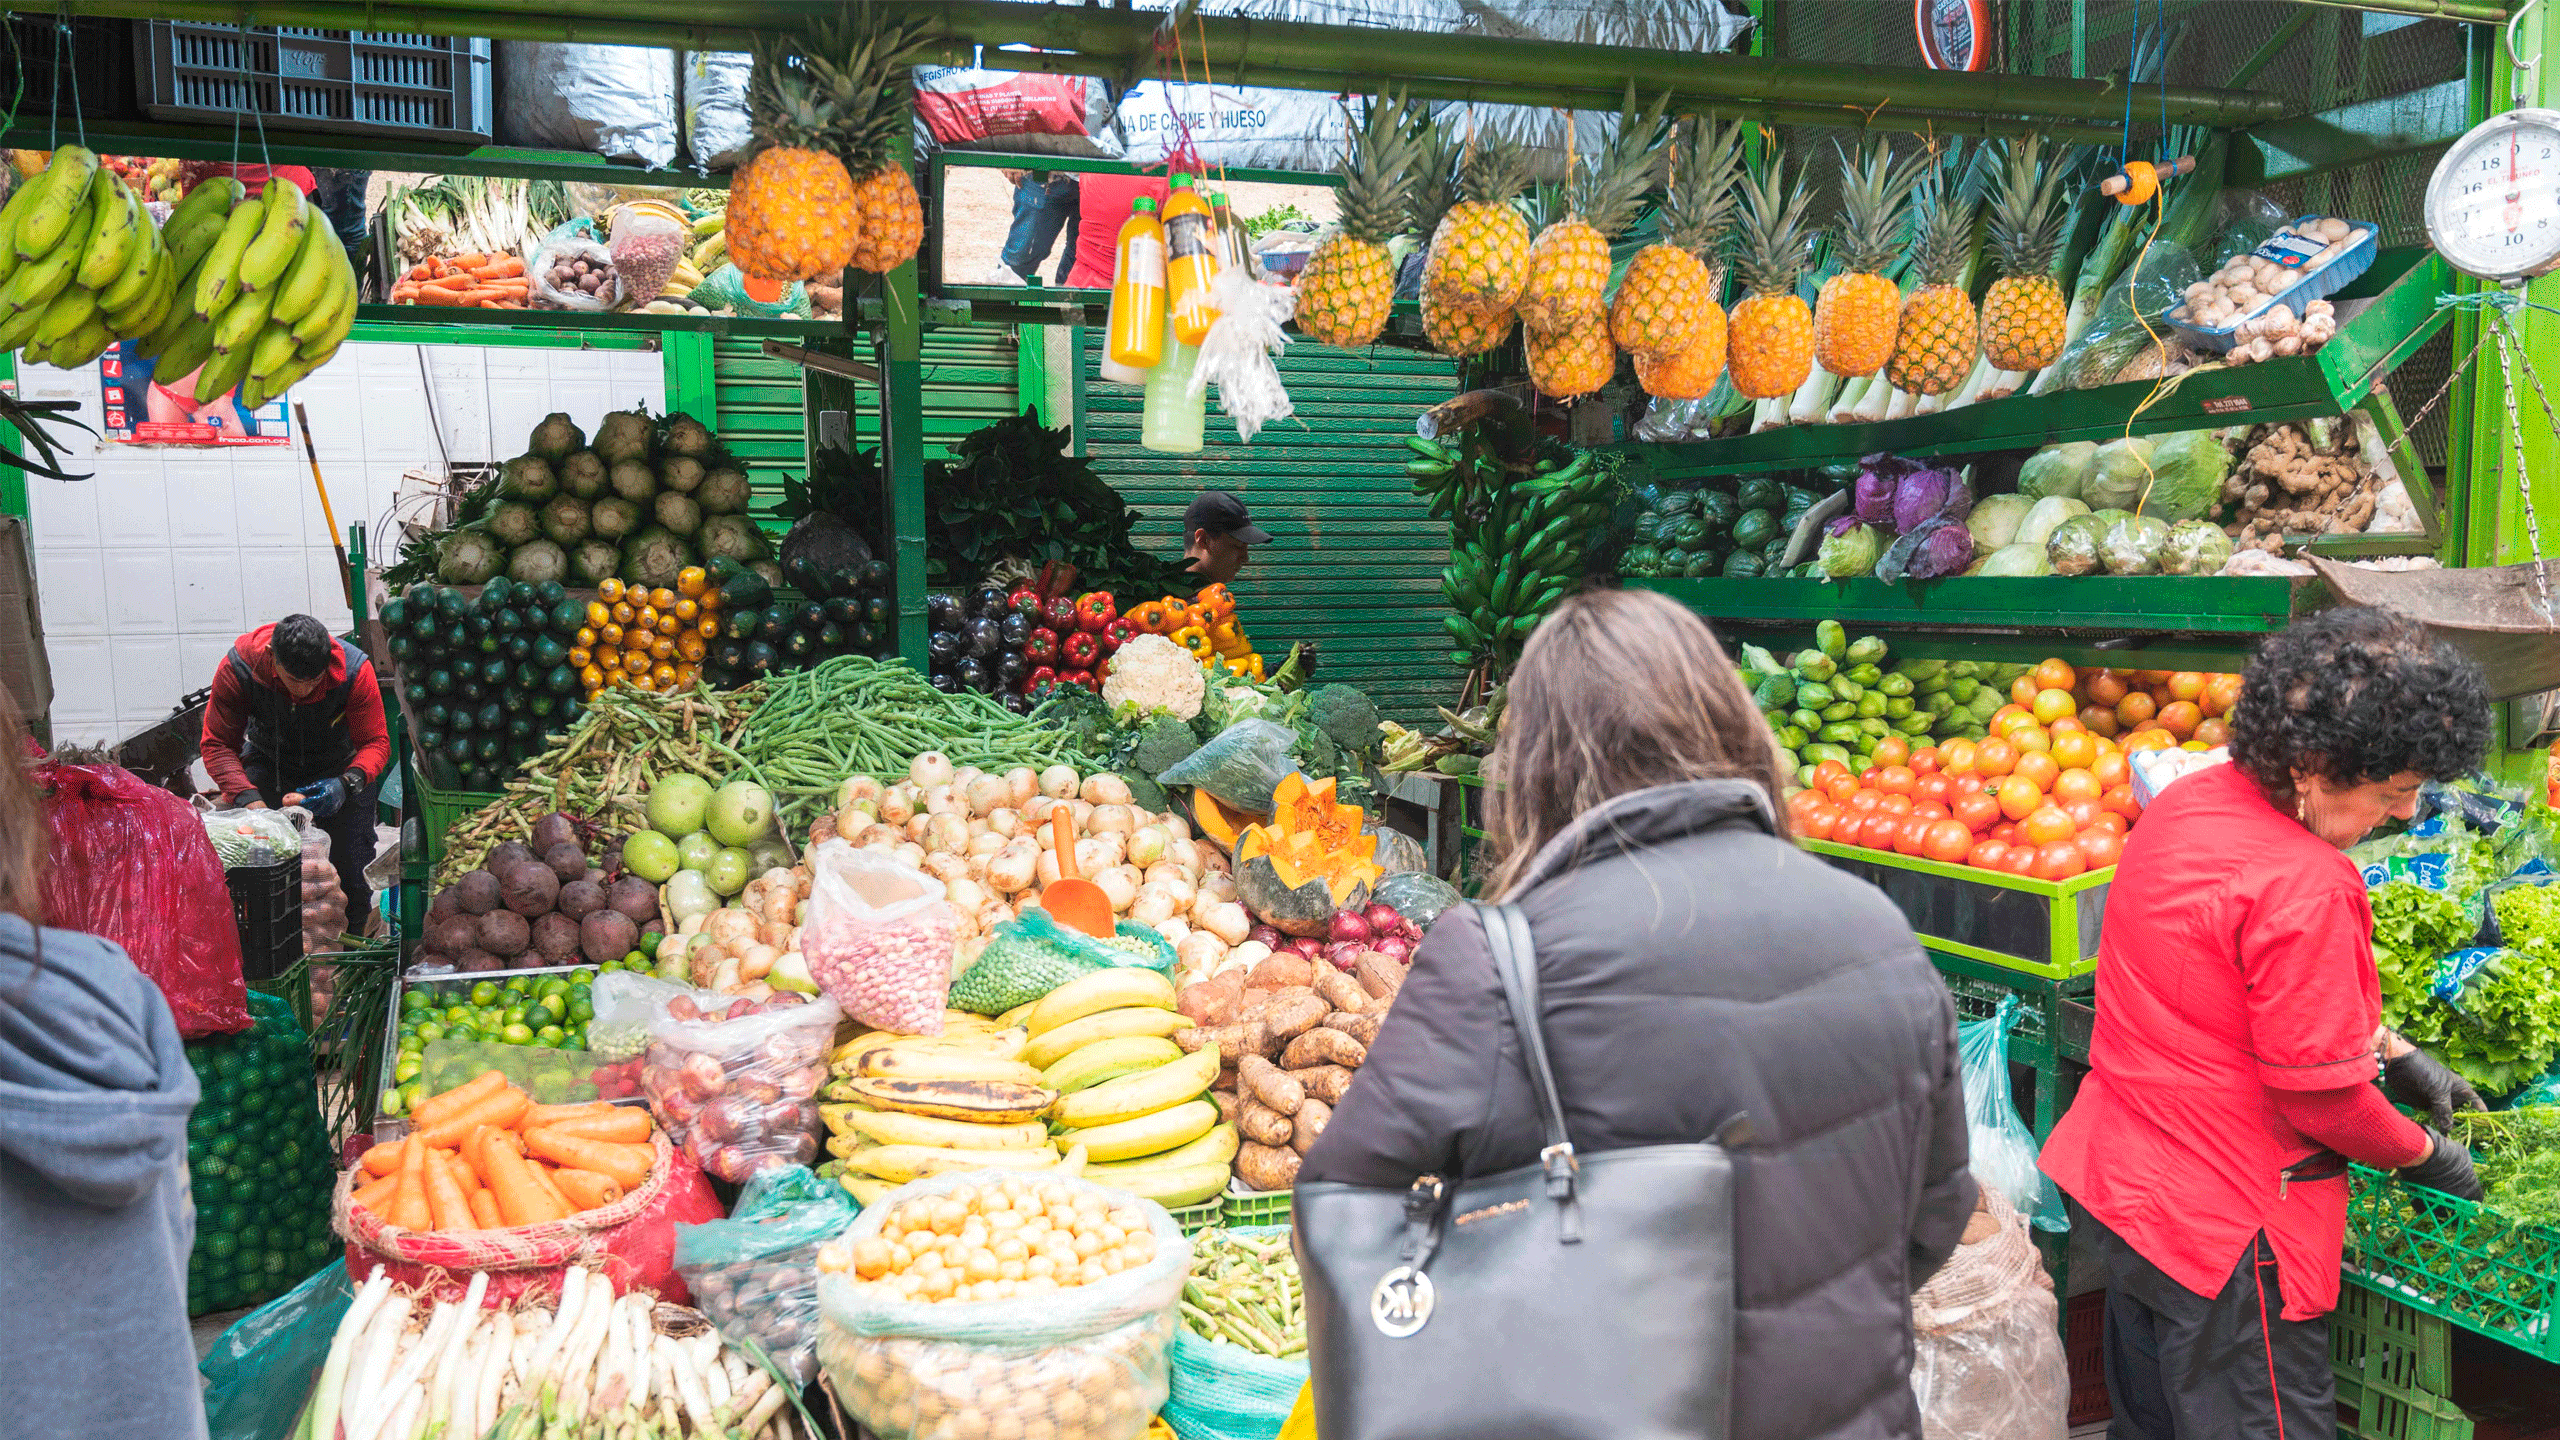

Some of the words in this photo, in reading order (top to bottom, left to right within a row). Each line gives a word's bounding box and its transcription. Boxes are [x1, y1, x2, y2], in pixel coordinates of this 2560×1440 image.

[1139, 114, 1157, 131] DE
[1160, 112, 1204, 131] CARNE
[1209, 111, 1218, 128] Y
[1221, 110, 1266, 129] HUESO
[2541, 148, 2551, 159] 2
[2481, 157, 2500, 171] 18
[2461, 182, 2482, 195] 16
[2504, 233, 2524, 246] 10
